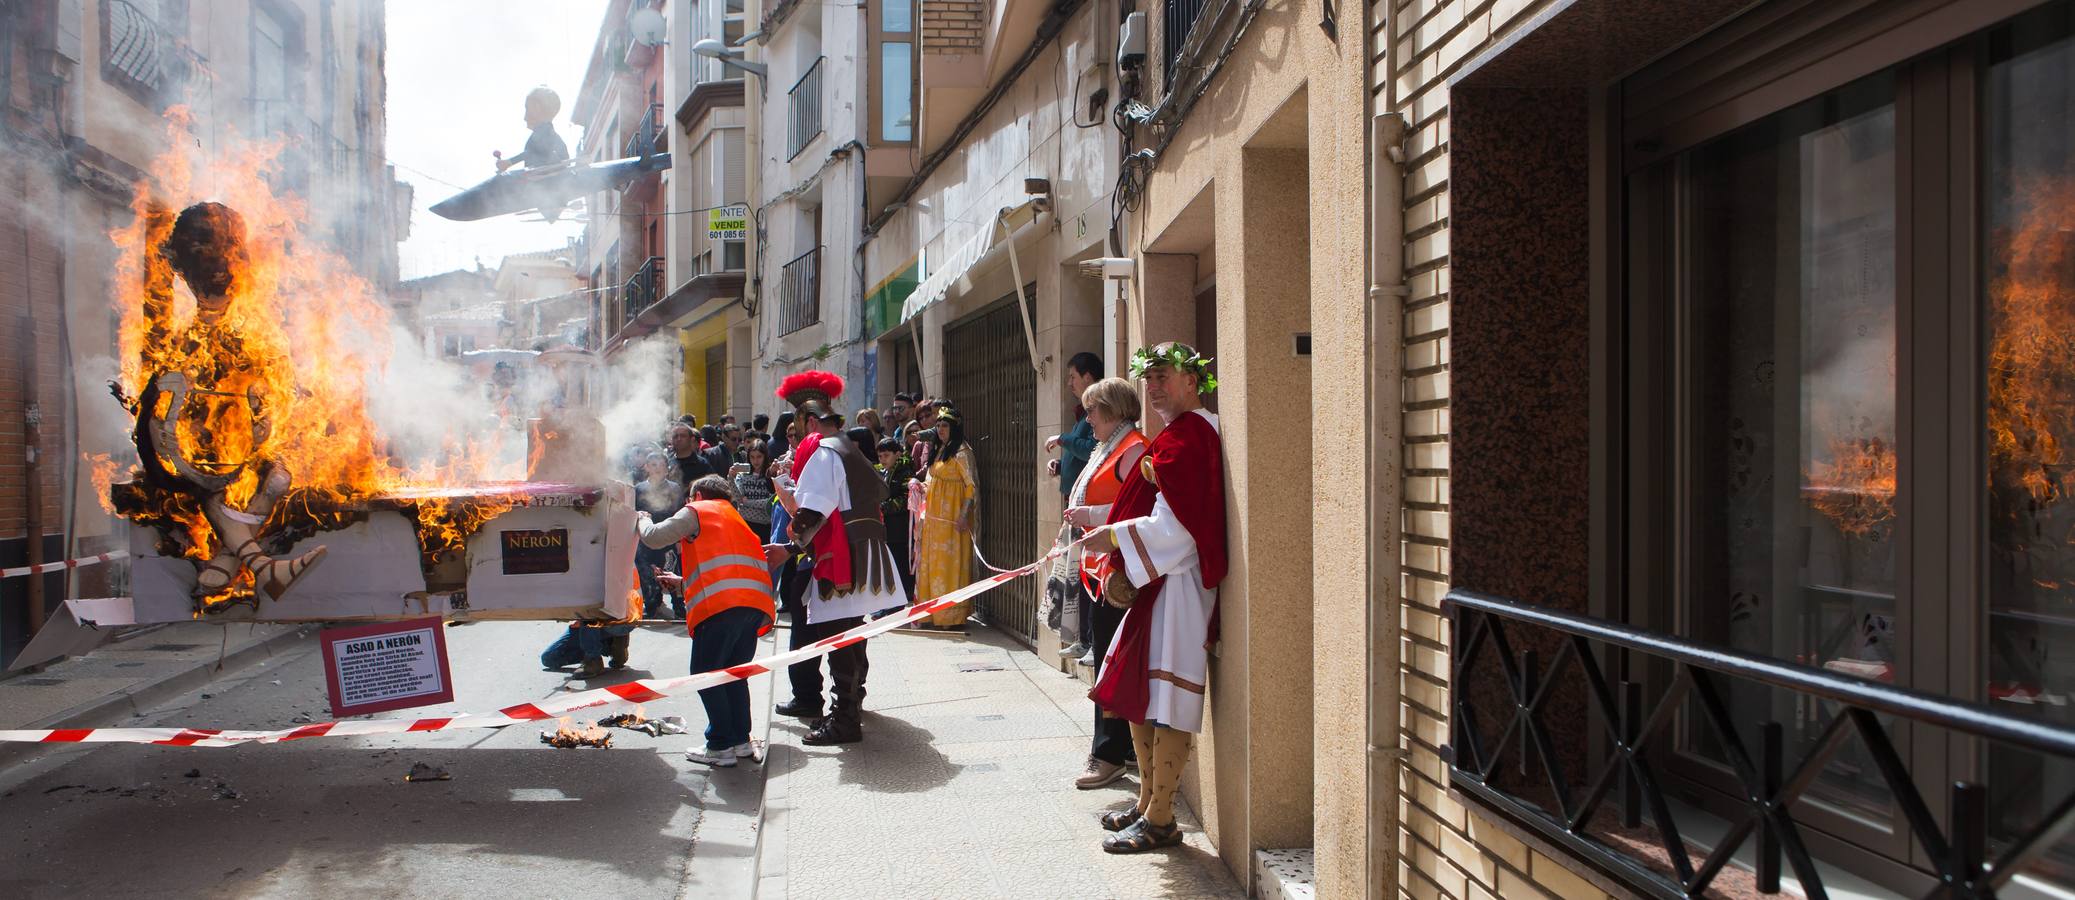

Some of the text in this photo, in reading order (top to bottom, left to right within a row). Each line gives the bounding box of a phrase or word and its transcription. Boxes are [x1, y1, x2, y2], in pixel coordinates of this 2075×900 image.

[714, 220, 746, 230] VENDE
[1077, 212, 1087, 238] 18
[709, 230, 722, 239] 601
[723, 230, 737, 238] 085
[346, 635, 421, 654] ASAD A NERÓN
